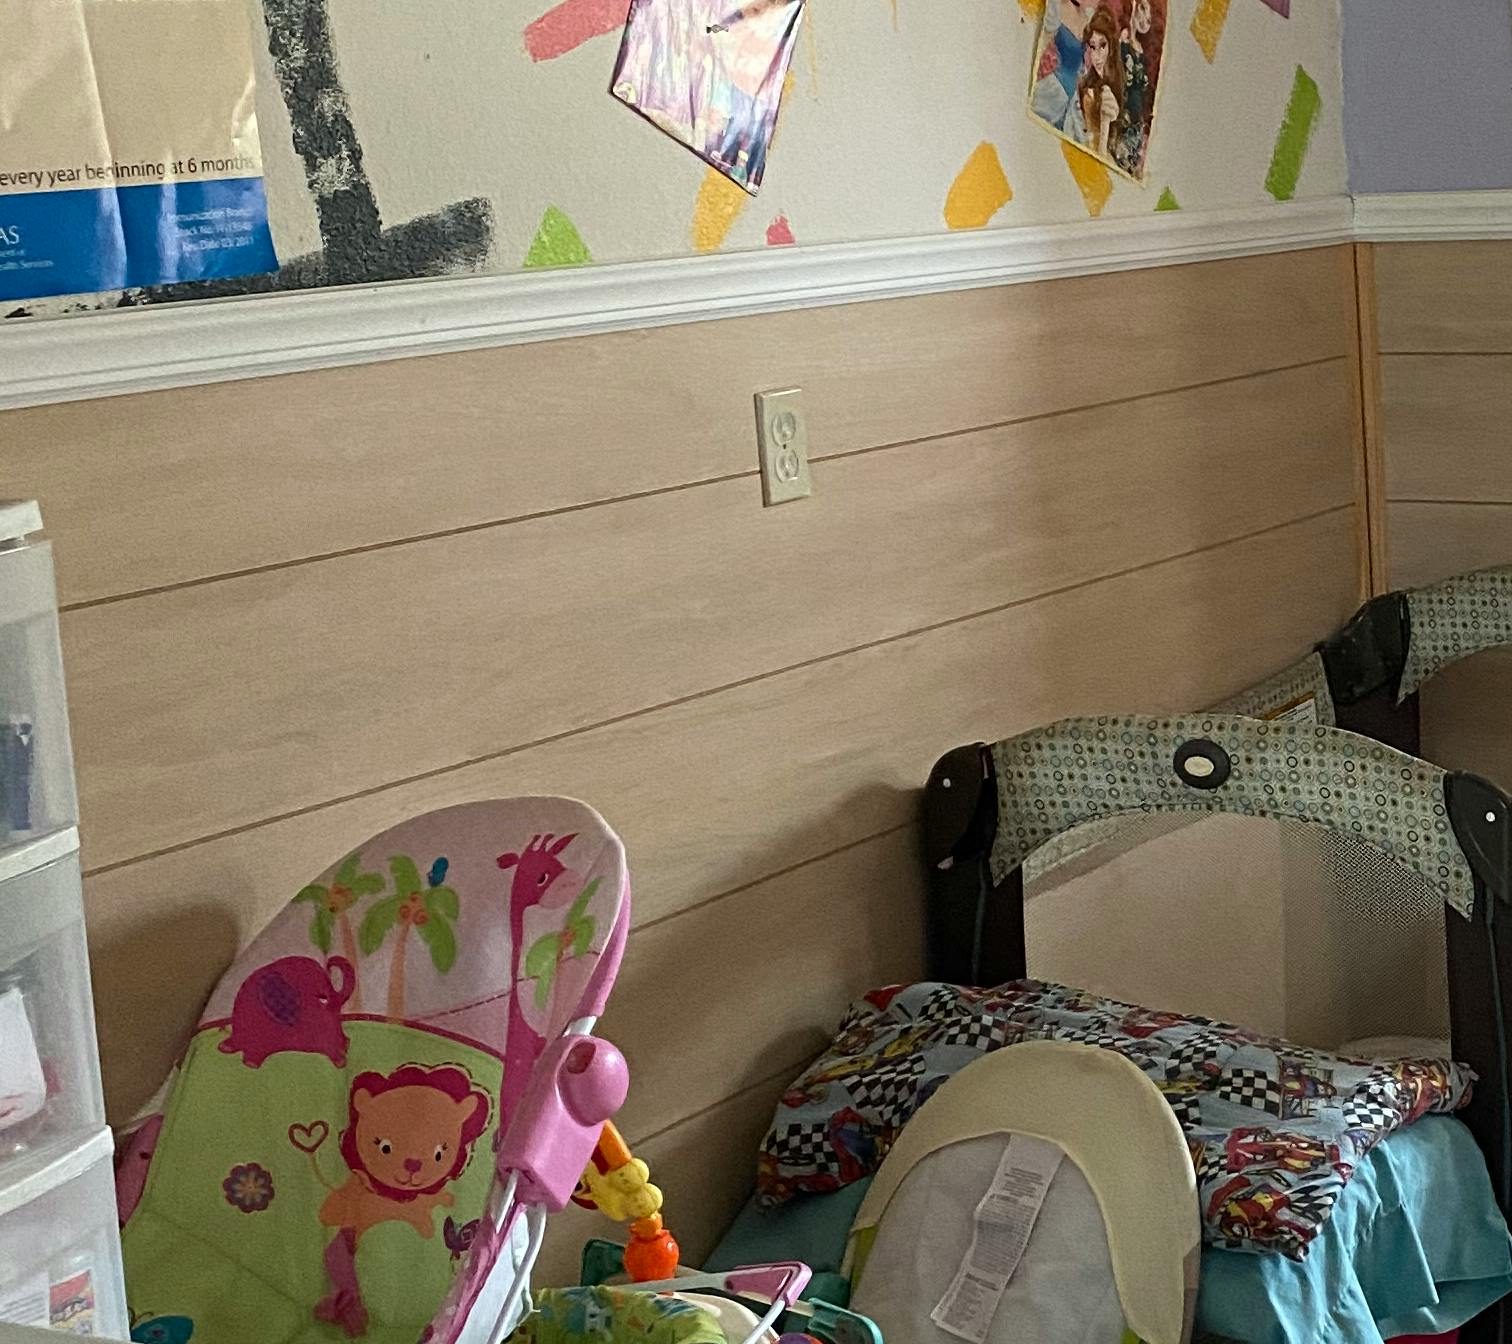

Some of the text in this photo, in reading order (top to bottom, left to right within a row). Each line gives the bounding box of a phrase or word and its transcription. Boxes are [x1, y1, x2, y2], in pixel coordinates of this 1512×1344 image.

[0, 170, 43, 188] every
[46, 167, 81, 188] year
[188, 158, 197, 173] 6
